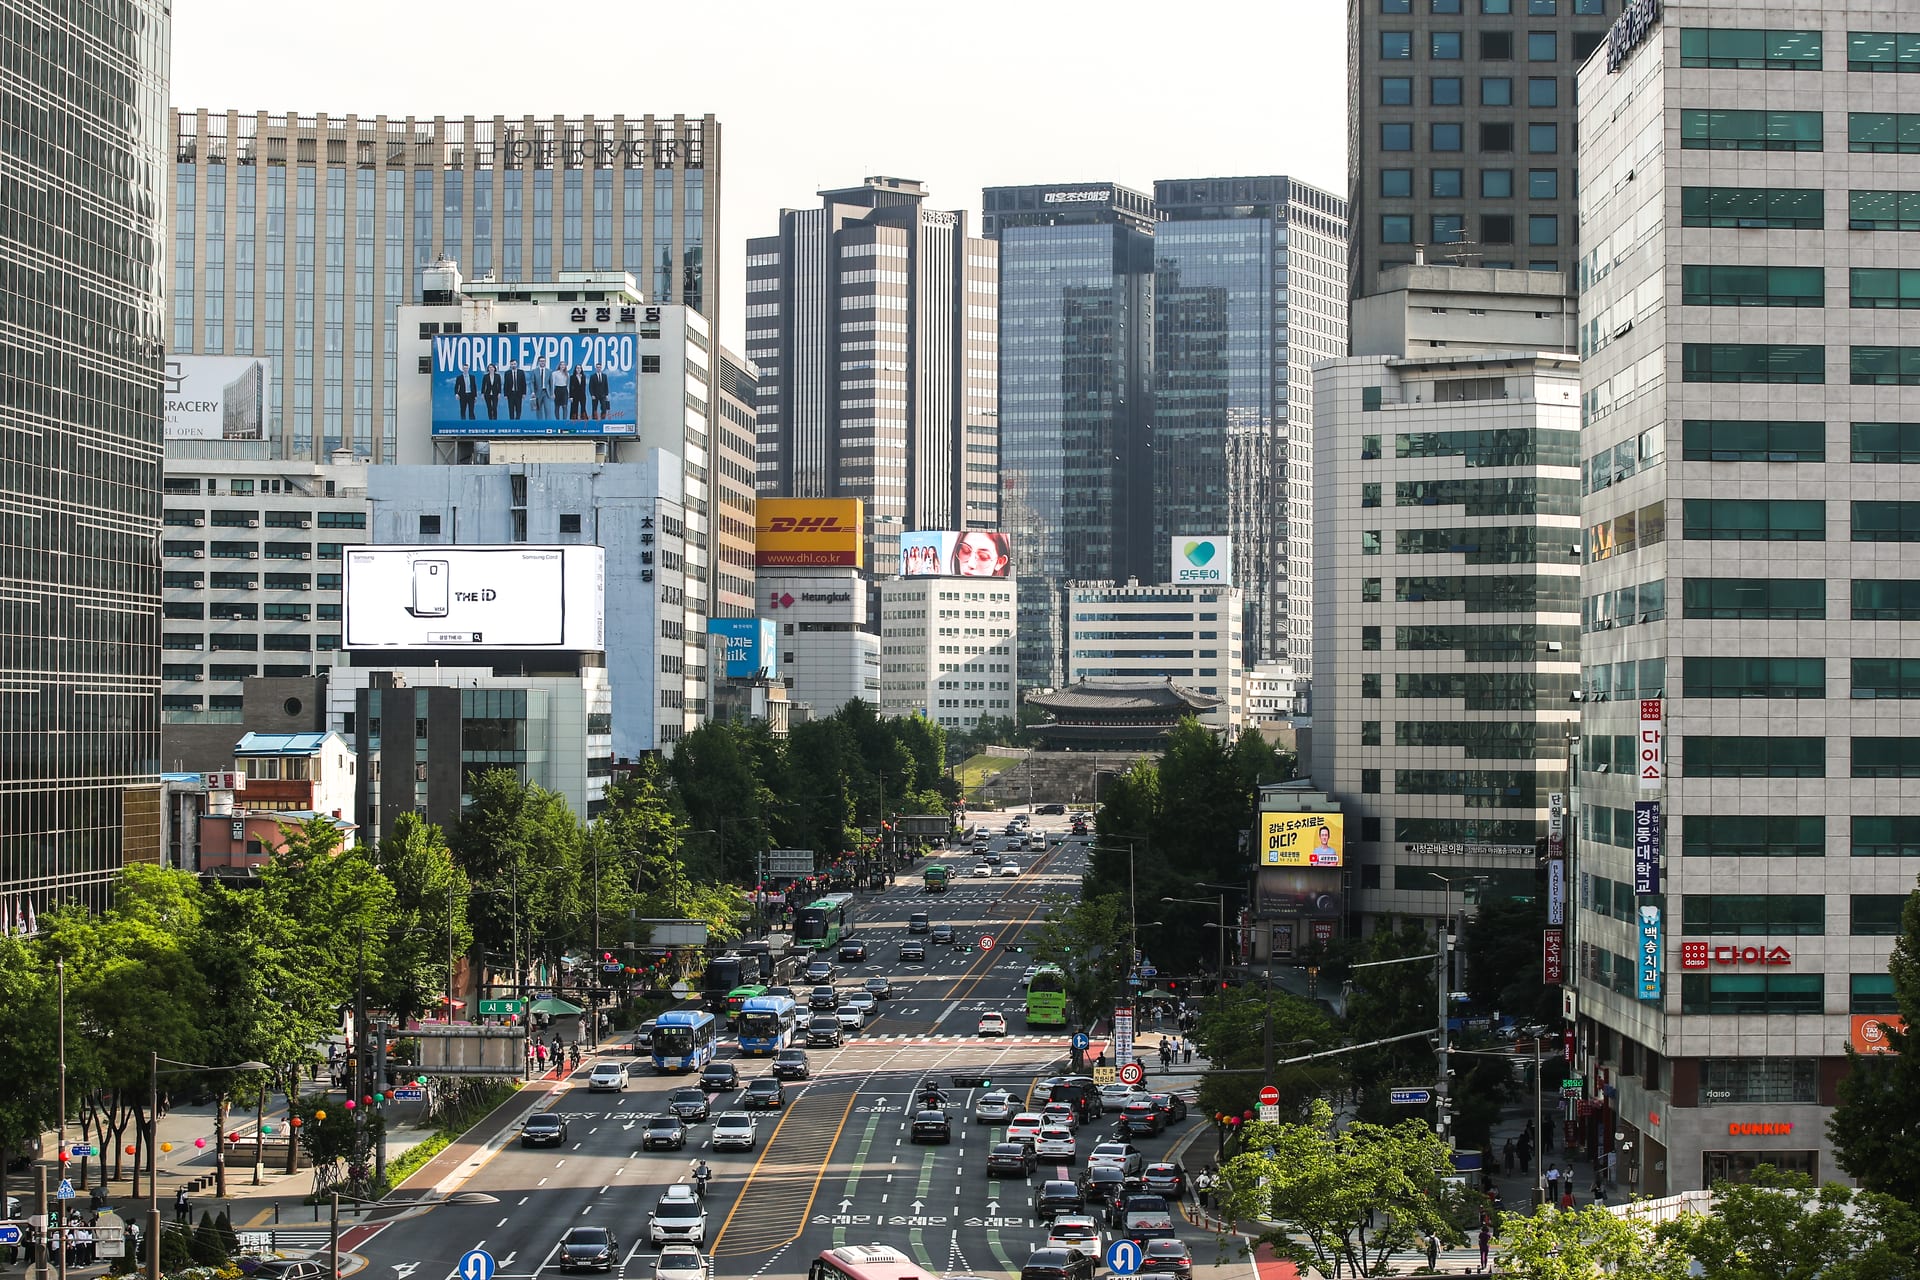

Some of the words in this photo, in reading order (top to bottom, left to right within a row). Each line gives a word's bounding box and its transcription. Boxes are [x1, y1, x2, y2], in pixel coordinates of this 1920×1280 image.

[493, 138, 577, 159] HOTEL
[580, 138, 695, 159] GRACERY
[1043, 189, 1111, 204] 대우조선해양
[571, 307, 661, 323] 삼정빌딩
[436, 336, 512, 372] WORLD
[518, 336, 573, 372] EXPO
[581, 336, 633, 372] 2030
[177, 428, 204, 436] OPEN
[768, 517, 844, 533] DHL
[768, 553, 840, 564] www.dhl.co.kr
[1179, 569, 1220, 581] 모두투어
[455, 592, 479, 602] THE
[801, 592, 851, 605] Heungkuk
[1641, 729, 1661, 779] 다이소
[1551, 794, 1562, 830] 단월드
[1269, 822, 1285, 834] 강남
[1286, 816, 1325, 831] 도수치료는
[1269, 832, 1298, 849] 어디?
[1635, 809, 1652, 893] 경동대학교
[1547, 943, 1561, 977] 손짜장
[1643, 926, 1658, 983] 백송치과
[1715, 945, 1792, 965] 다이소
[487, 1003, 514, 1013] 시청
[1124, 1068, 1138, 1080] 50
[1706, 1089, 1731, 1098] daiso
[1728, 1122, 1795, 1136] DUNKIN'
